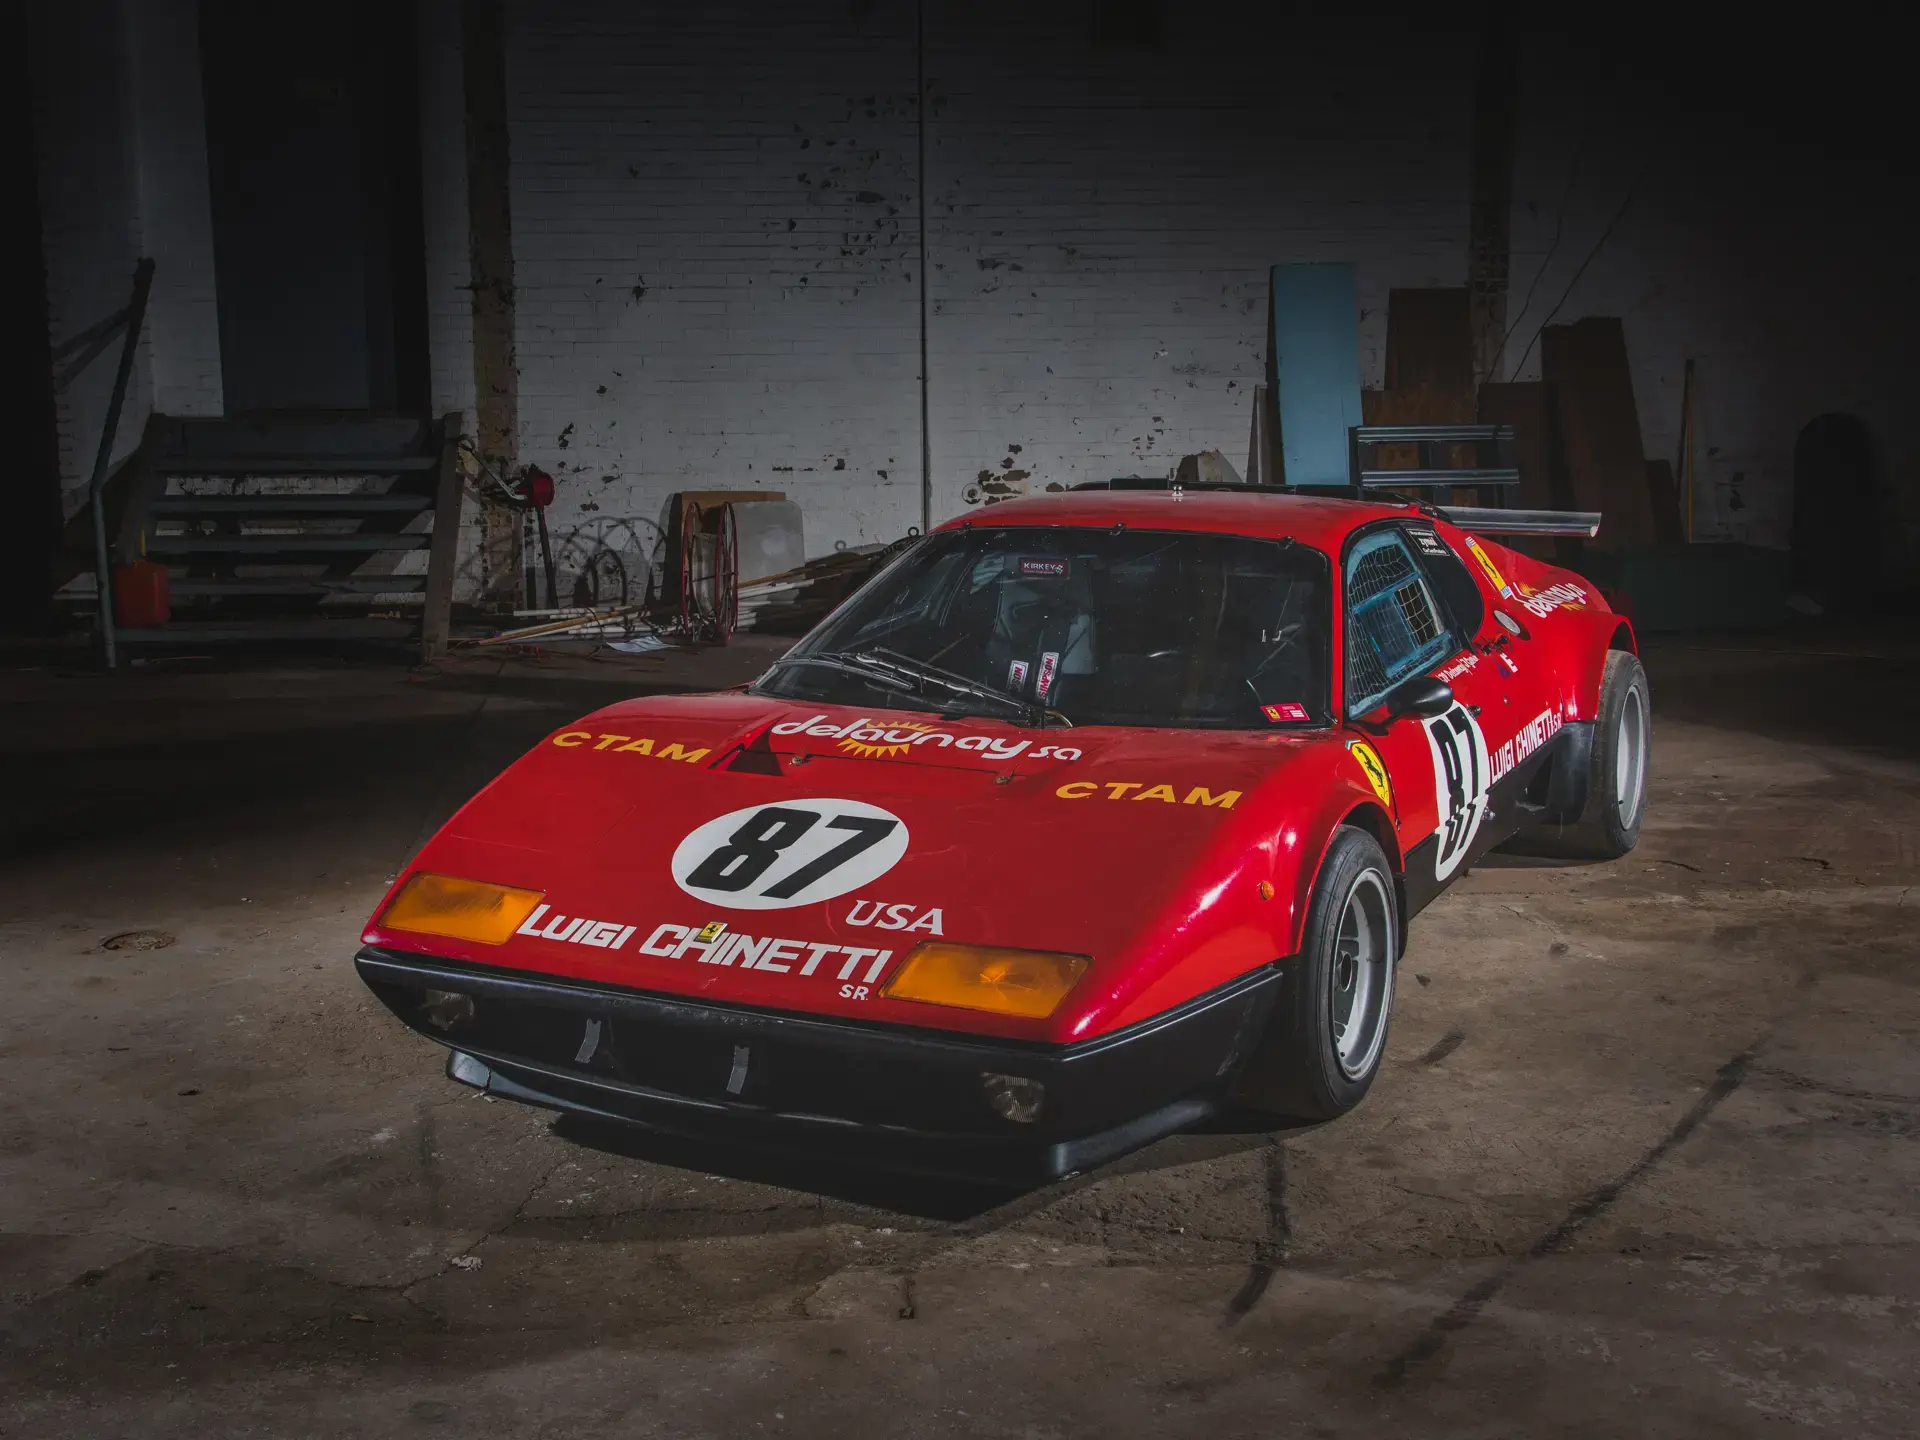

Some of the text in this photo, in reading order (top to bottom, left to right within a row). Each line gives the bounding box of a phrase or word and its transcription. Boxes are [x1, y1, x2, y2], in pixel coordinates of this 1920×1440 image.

[1023, 562, 1056, 570] KIRKEY
[1040, 657, 1054, 697] SIMPSON
[771, 715, 1033, 759] delaunay
[1490, 739, 1515, 785] LUIGI
[1515, 708, 1554, 763] CHINETTI
[1429, 706, 1479, 865] 87
[685, 807, 900, 900] 87
[516, 904, 893, 984] LUIGI CHINETTI
[845, 900, 945, 936] USA
